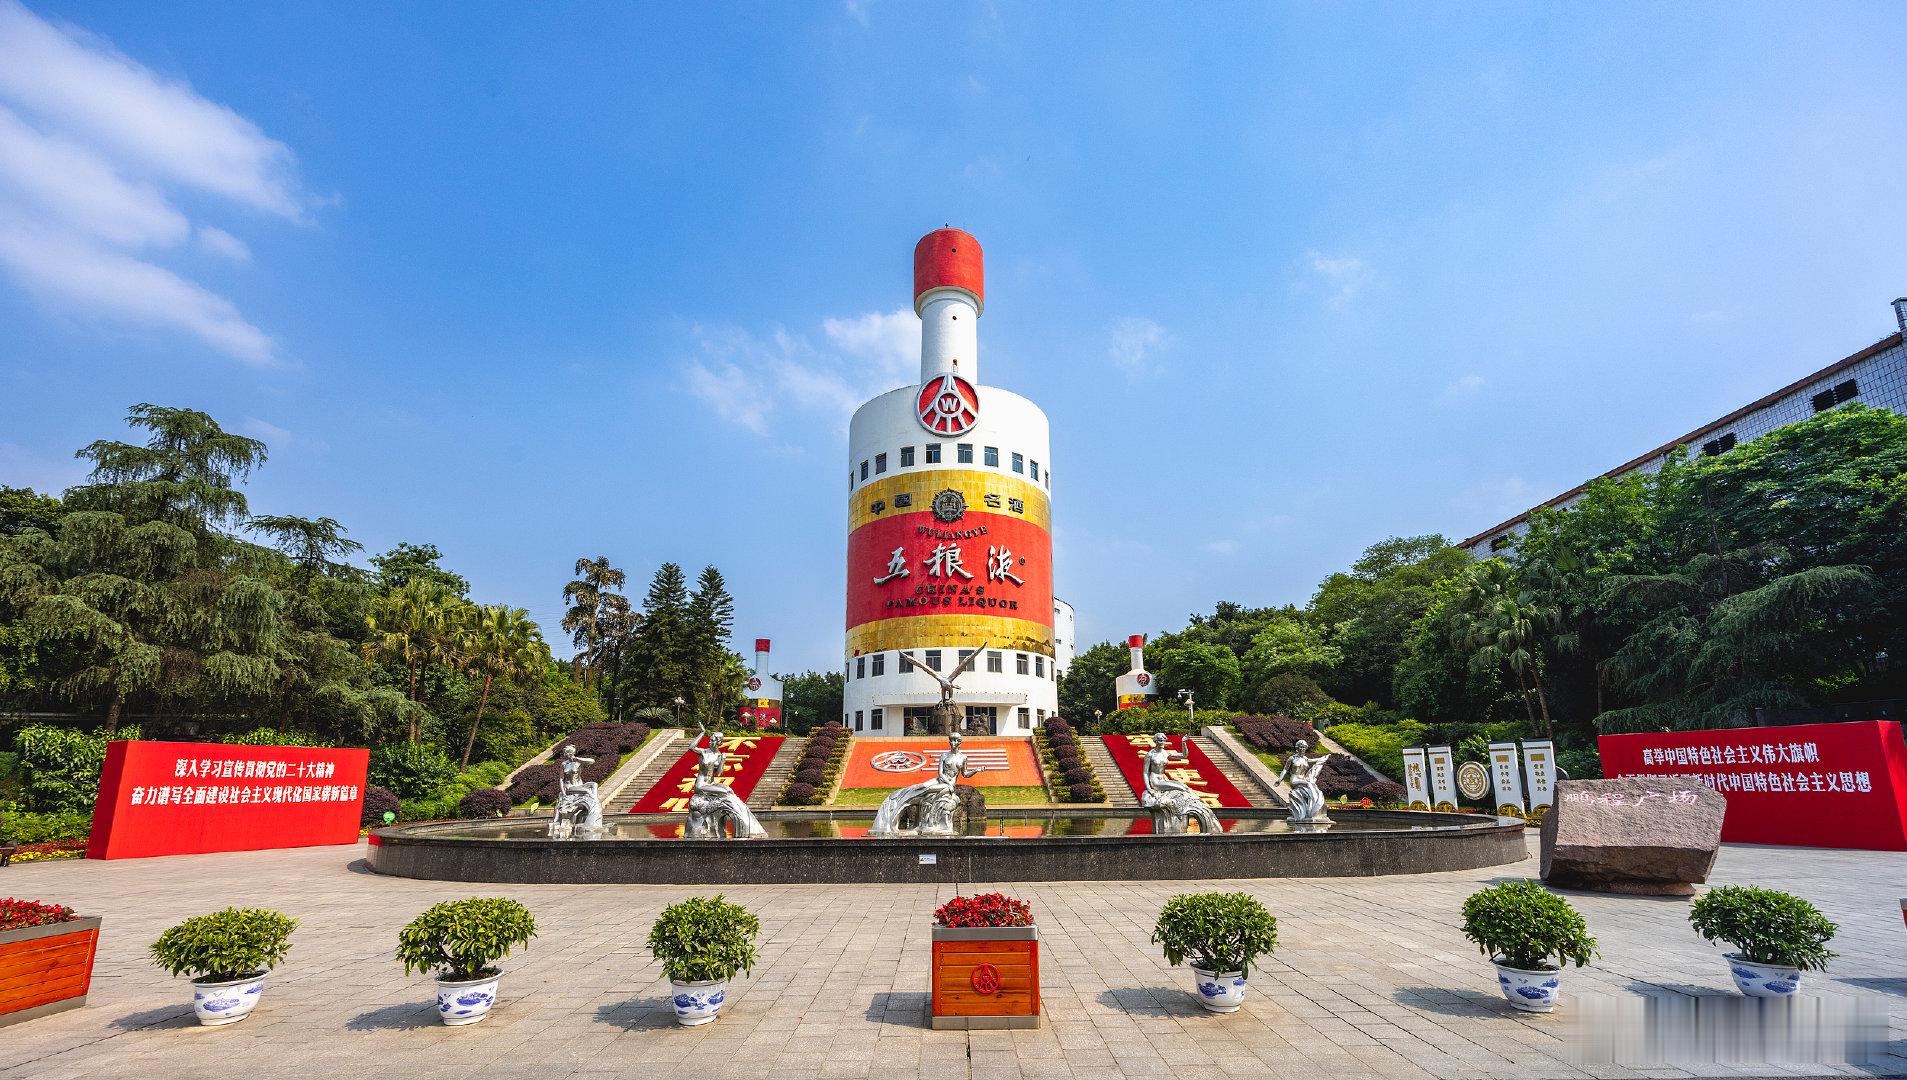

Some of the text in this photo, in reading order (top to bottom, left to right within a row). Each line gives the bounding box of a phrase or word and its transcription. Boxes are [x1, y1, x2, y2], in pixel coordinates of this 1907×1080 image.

[984, 492, 1024, 514] 名酒
[918, 525, 988, 541] WULIANGYE
[874, 542, 1025, 587] 五粮液
[915, 584, 985, 595] CHINA'S
[887, 596, 1018, 610] FAMOUS LIQUOR
[1642, 742, 1820, 766] 高举中国特色社会主义伟大旗帜
[174, 758, 335, 779] 深入学习宣传贯彻党的二十大精神
[1617, 771, 1872, 793] 时代中国特色社会主义思想
[131, 784, 358, 806] 奋力谱写全面建设社会主义现代化国家崭新篇章
